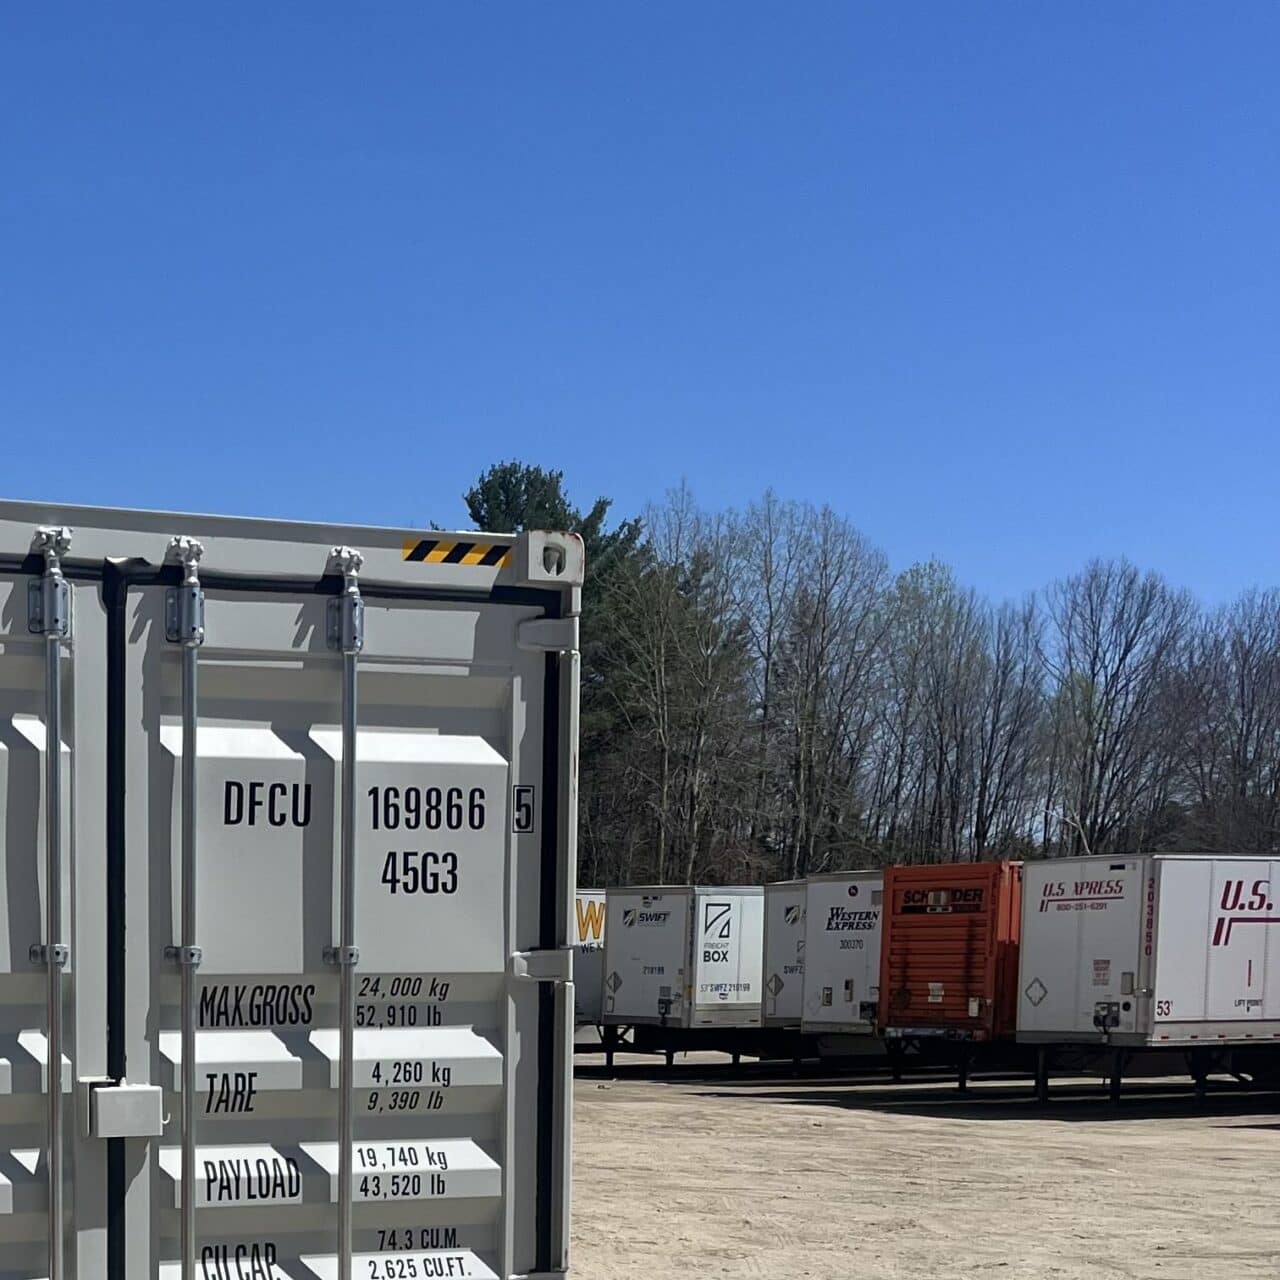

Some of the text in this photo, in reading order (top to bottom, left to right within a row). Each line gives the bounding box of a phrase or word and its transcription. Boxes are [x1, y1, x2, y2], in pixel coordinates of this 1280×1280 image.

[223, 781, 533, 832] DFCU 169866 5
[381, 851, 458, 894] 45G3
[903, 888, 983, 905] SCHDER
[1220, 880, 1273, 911] U.S.
[640, 912, 670, 922] SWIFT
[830, 907, 879, 921] WESTERN
[703, 951, 728, 962] BOX
[199, 977, 450, 1027] MAX.GROSS 24,000 kg
[356, 1004, 442, 1029] 52,910 lb
[205, 1061, 452, 1113] TARE 4,260 kg
[367, 1091, 444, 1113] 9,390 lb
[203, 1146, 449, 1201] PAYLOAD 19,740 kg
[359, 1174, 446, 1198] 43,520 lb
[378, 1230, 413, 1251] 74.3
[421, 1228, 461, 1249] CU.M.
[368, 1257, 472, 1280] 2,625 CU.FT.
